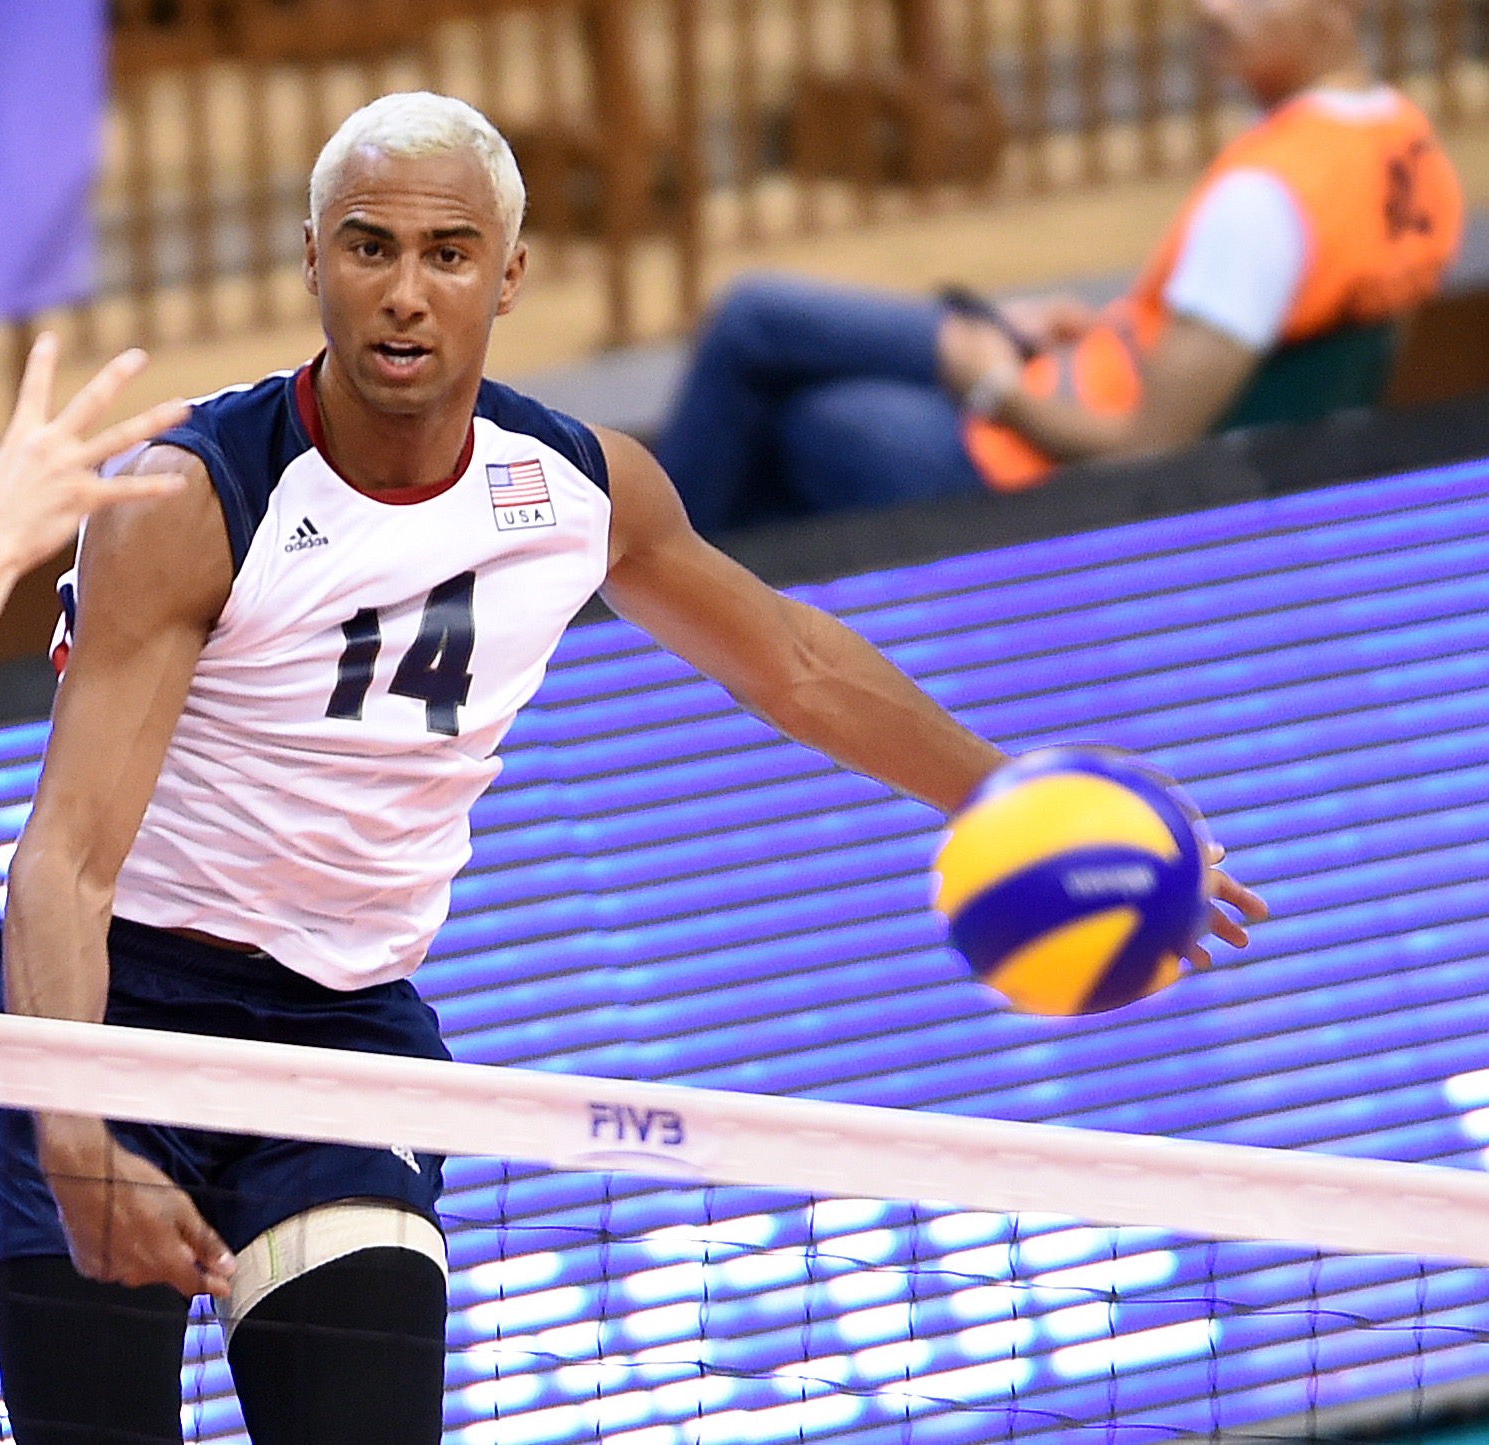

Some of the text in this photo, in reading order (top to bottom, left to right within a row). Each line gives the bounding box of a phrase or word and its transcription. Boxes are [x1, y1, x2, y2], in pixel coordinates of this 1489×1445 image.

[503, 509, 545, 525] USA
[284, 536, 330, 553] adidas
[325, 571, 476, 736] 14
[589, 1103, 685, 1145] FIVB
